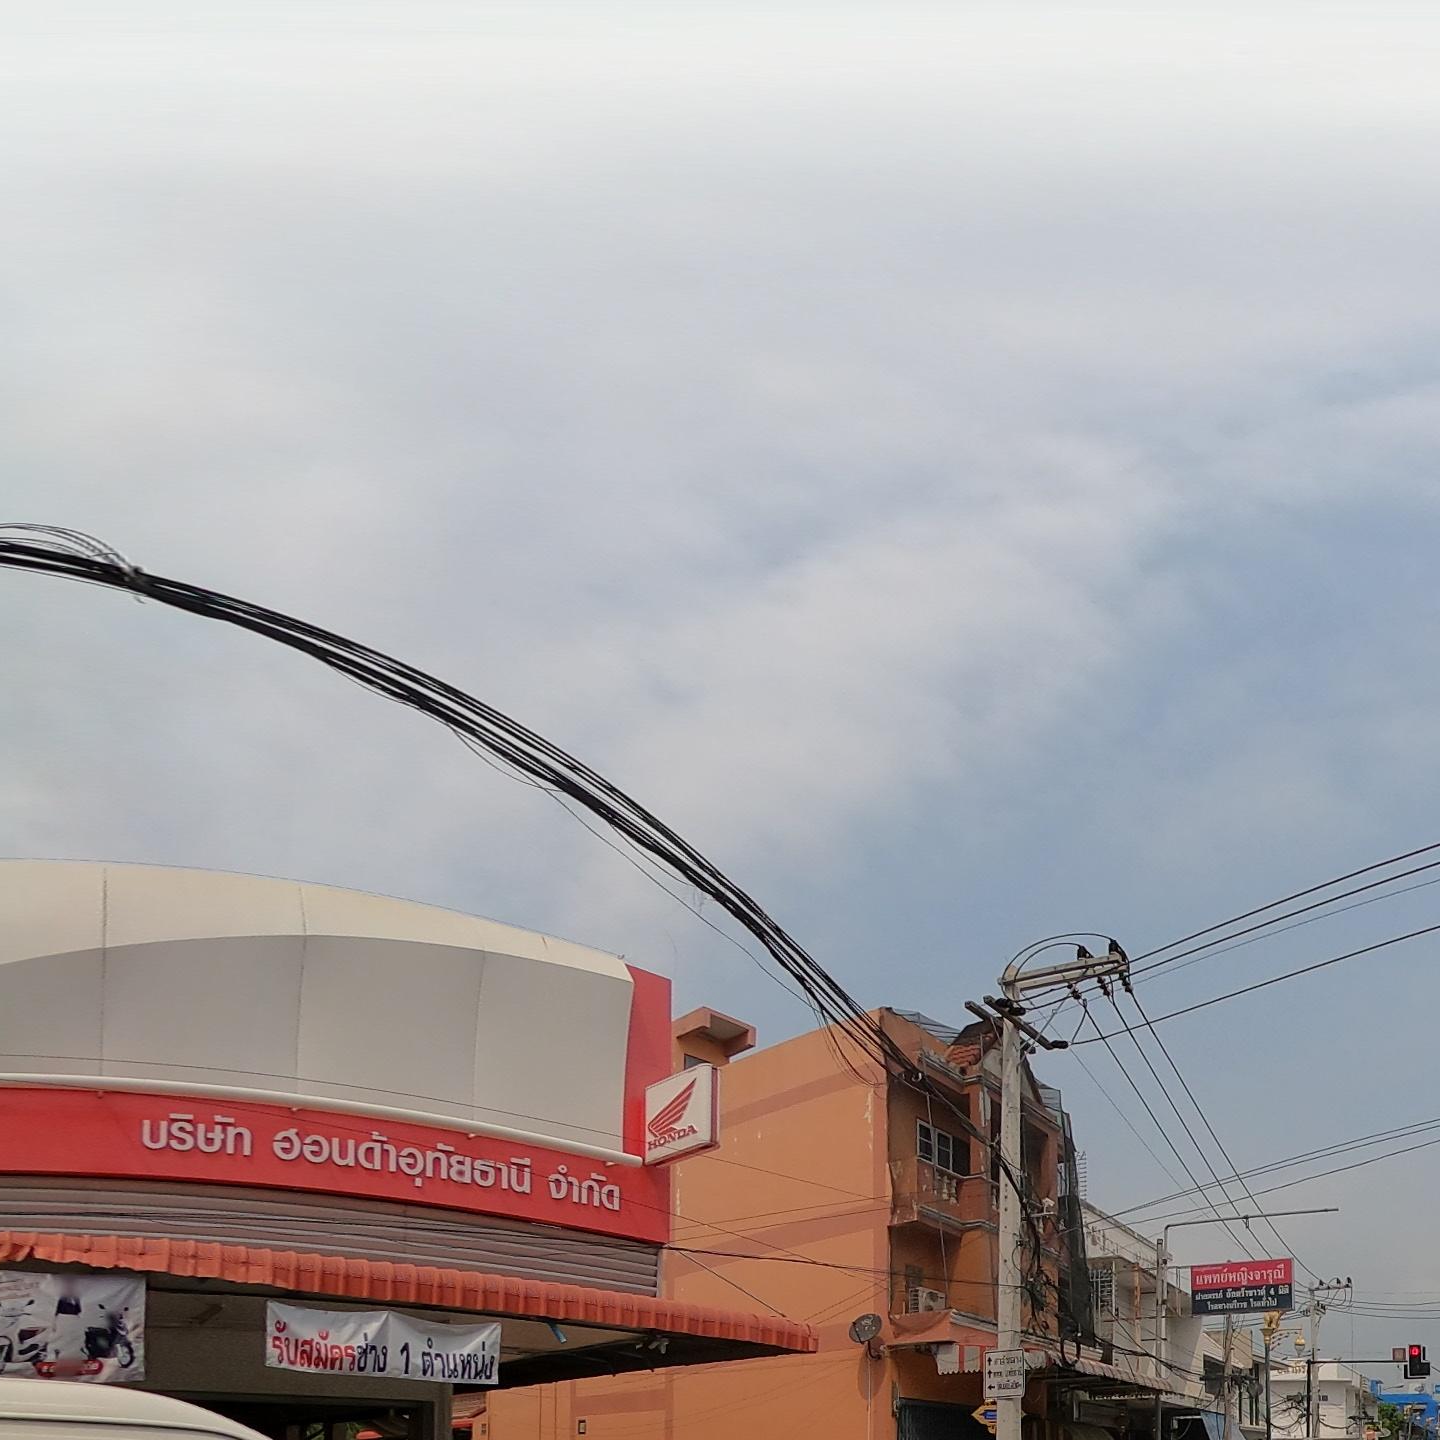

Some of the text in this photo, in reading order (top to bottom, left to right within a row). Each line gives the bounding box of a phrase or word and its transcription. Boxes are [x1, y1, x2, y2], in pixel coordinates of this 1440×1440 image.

[141, 1112, 621, 1212] บริษัท ฮอนด้าอุทัยธานี จำกัด
[647, 1124, 698, 1151] HONDA
[271, 1319, 495, 1381] รับสมัครช่าง 1 ตำแหน่ง
